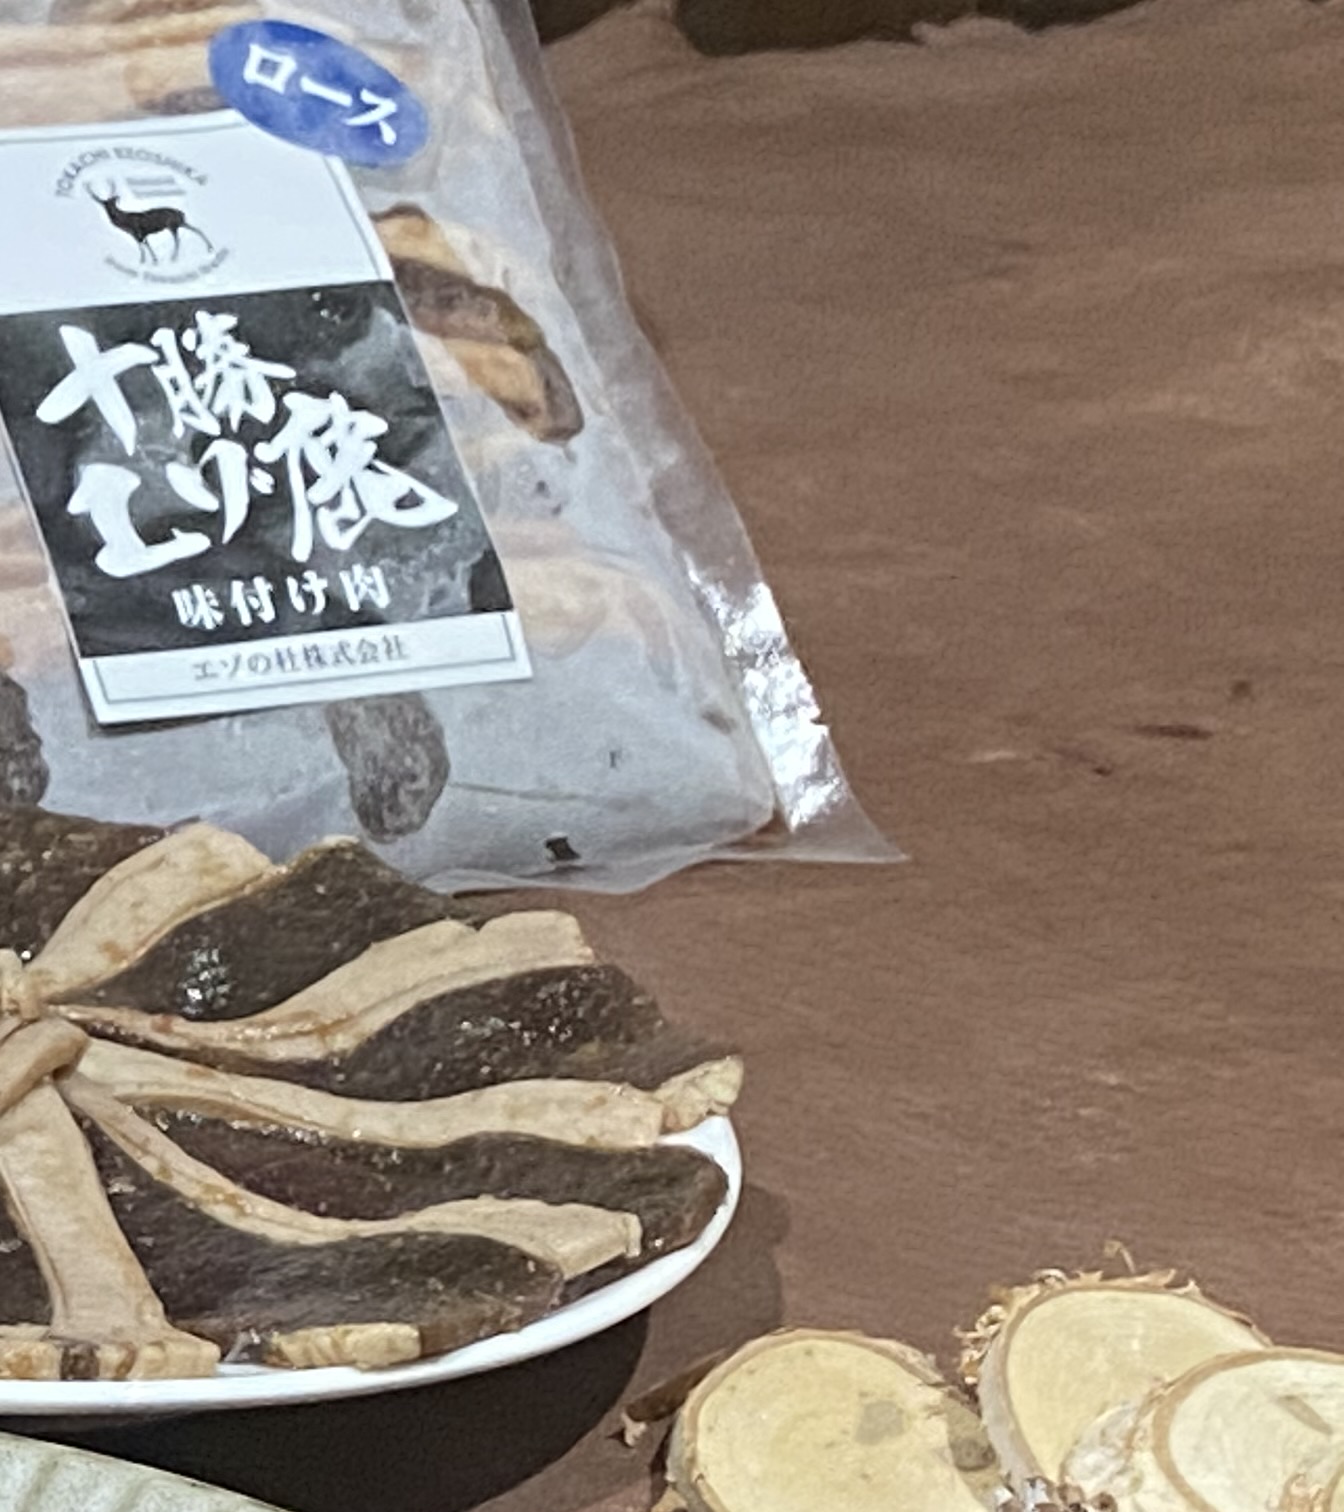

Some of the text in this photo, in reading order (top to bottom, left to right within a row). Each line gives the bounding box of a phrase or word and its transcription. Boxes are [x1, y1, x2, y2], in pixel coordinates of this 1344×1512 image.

[242, 42, 399, 146] ロース
[35, 309, 297, 457] 十勝
[170, 562, 393, 631] 味付け肉
[193, 633, 410, 681] エゾの杜株式会社
